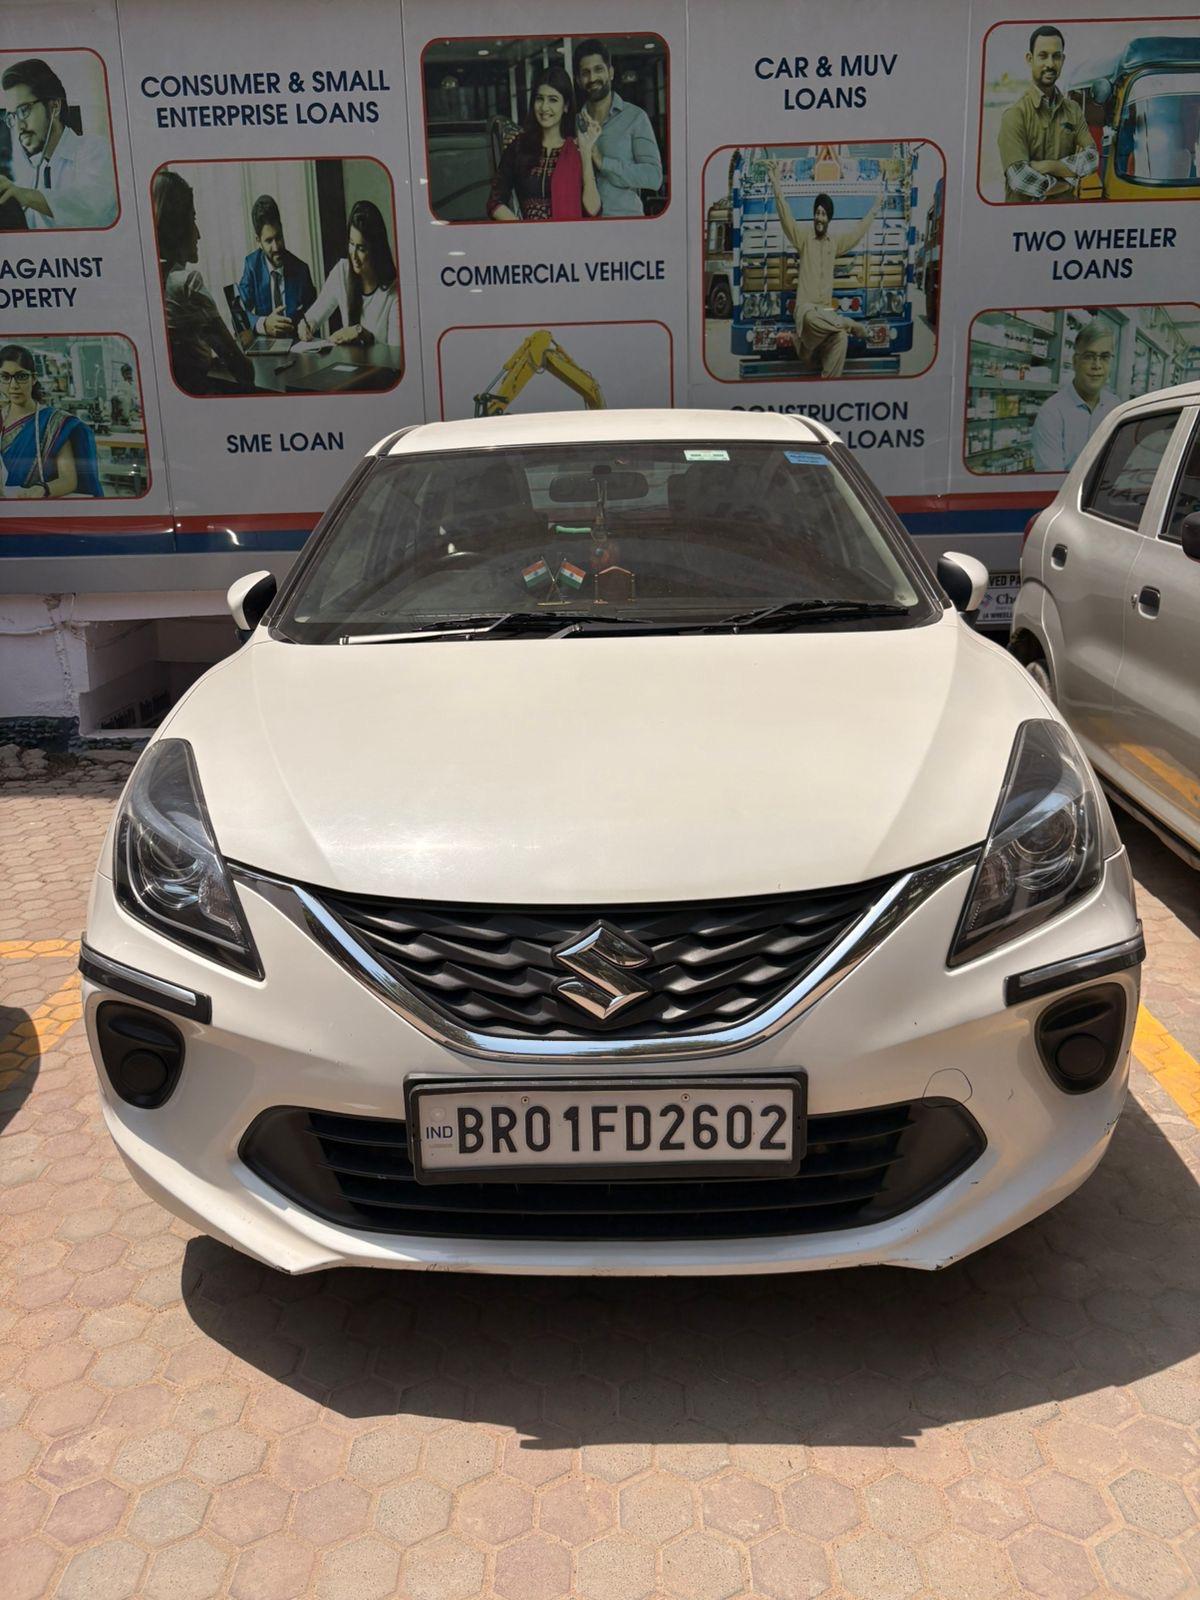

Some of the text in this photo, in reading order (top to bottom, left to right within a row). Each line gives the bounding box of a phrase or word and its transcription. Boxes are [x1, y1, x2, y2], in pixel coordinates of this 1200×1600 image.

[755, 54, 898, 80] CAR & MUV
[141, 70, 391, 98] CONSUMER & SMALL
[784, 87, 867, 110] LOANS
[156, 101, 380, 128] ENTERPRISE LOANS
[1012, 227, 1177, 252] TWO WHEELER
[0, 257, 103, 279] AGAINST
[440, 260, 665, 287] COMMERCIAL VEHICLE
[1052, 258, 1133, 280] LOANS
[226, 432, 344, 454] SME LOAN
[847, 429, 924, 449] LOANS
[426, 1126, 453, 1139] IND
[457, 1104, 787, 1154] BR01FD2602
